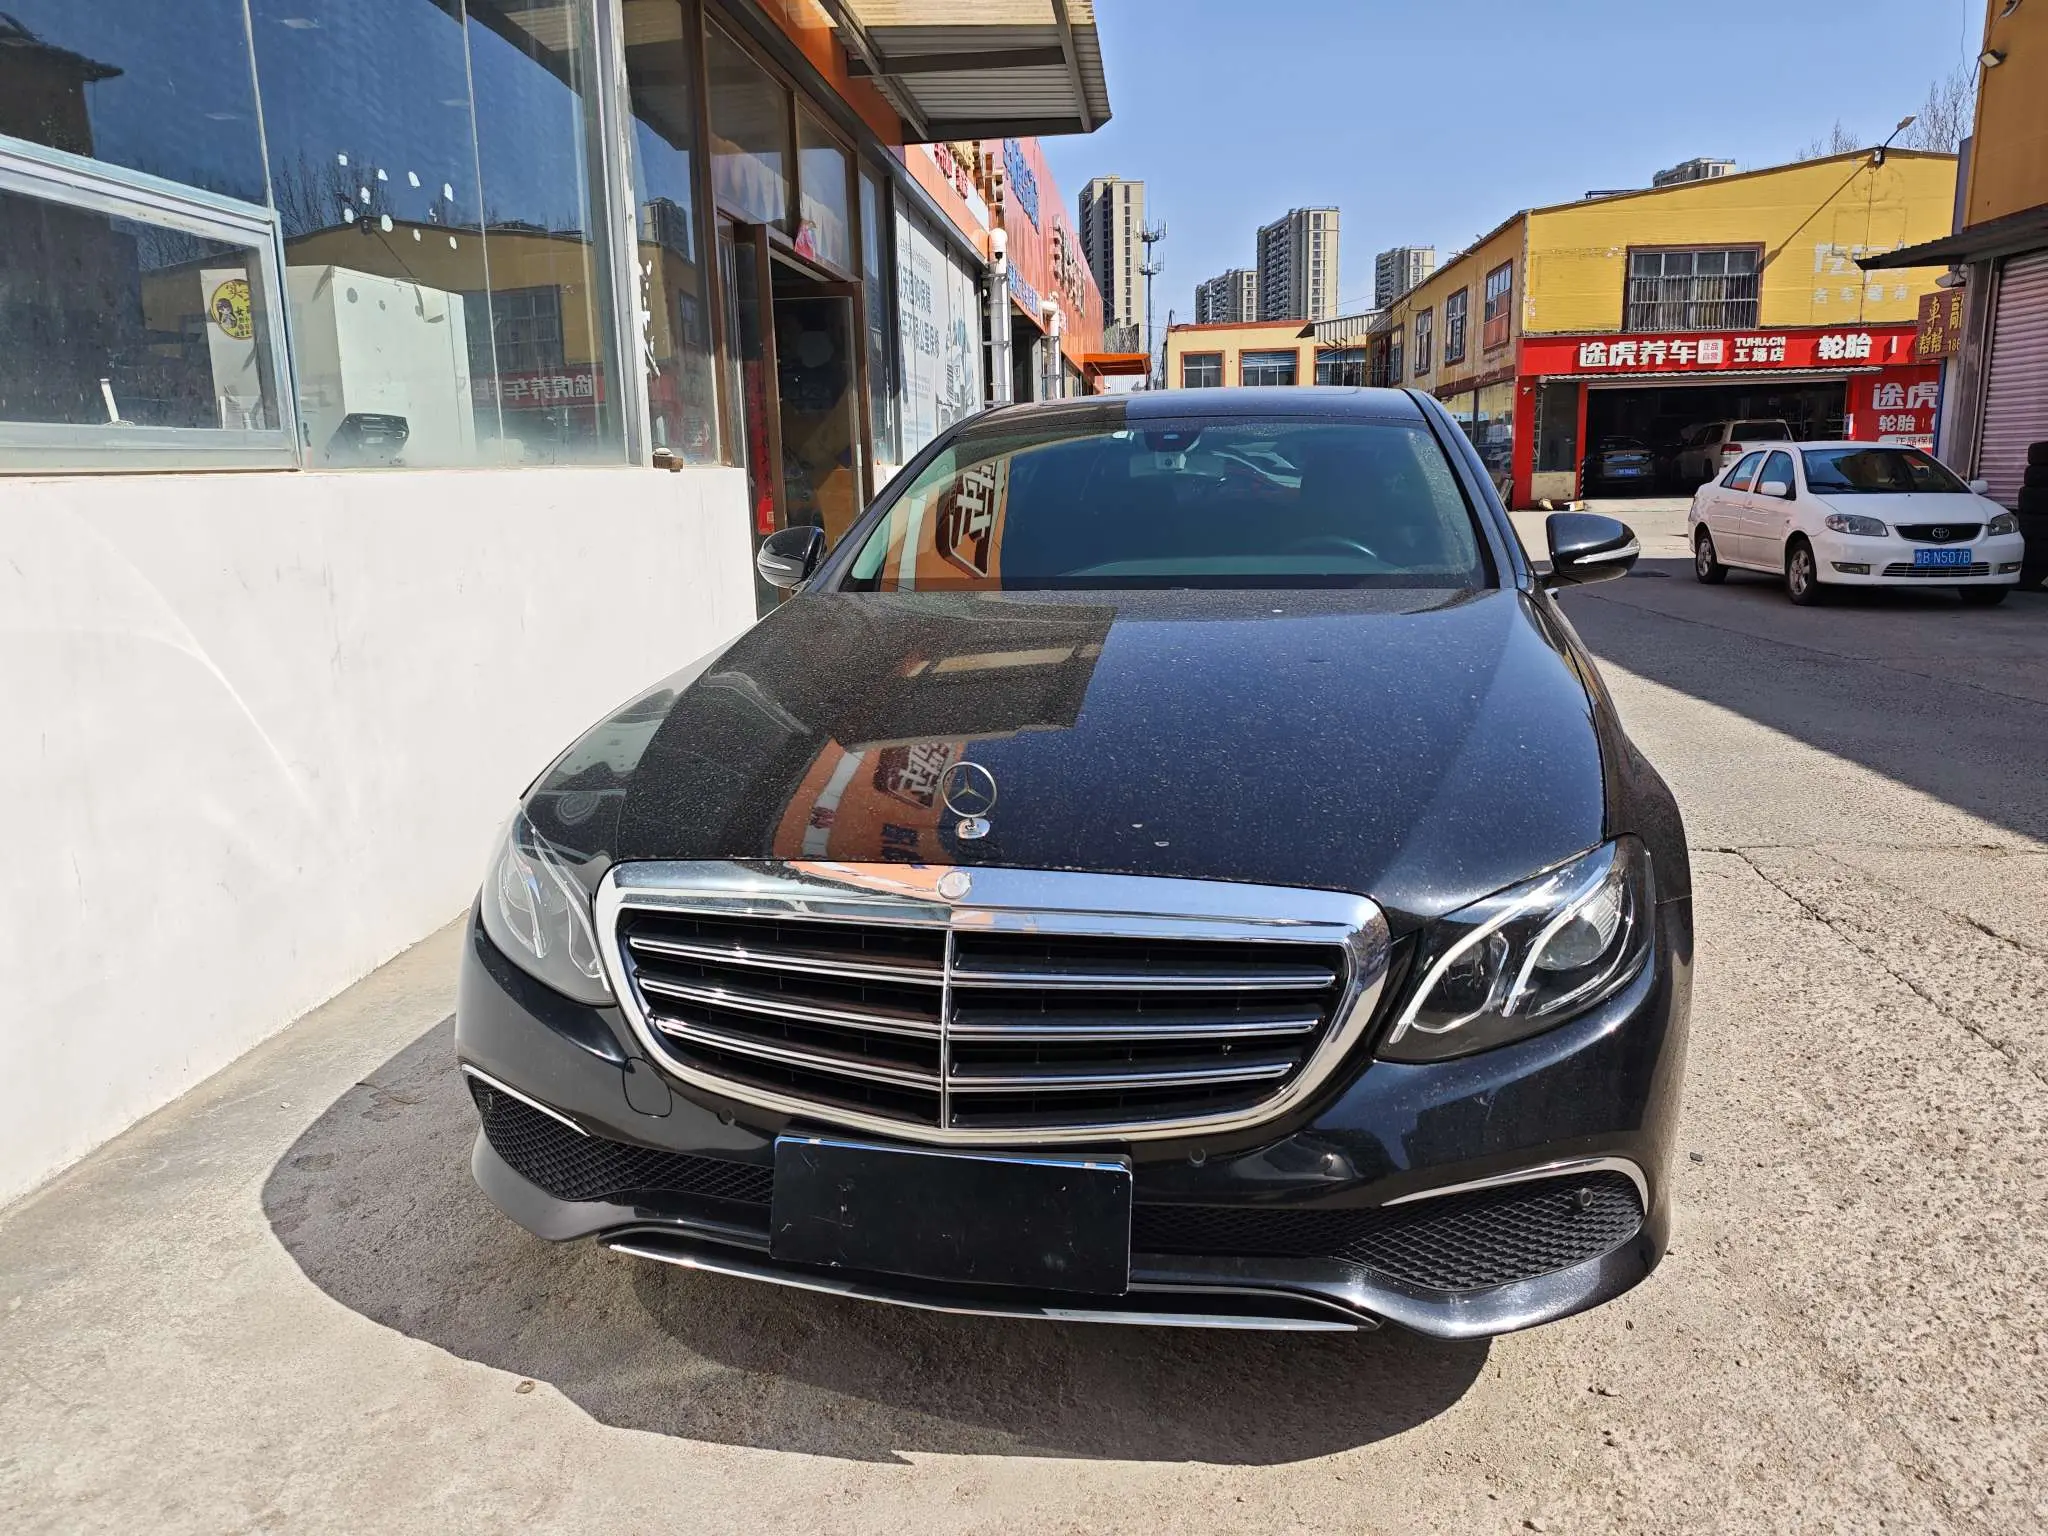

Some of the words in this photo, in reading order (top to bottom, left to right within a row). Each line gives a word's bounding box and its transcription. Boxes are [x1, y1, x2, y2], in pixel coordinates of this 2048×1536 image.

[1734, 336, 1785, 347] TUHU.CN
[1818, 333, 1873, 360] 轮胎
[1579, 339, 1697, 367] 途虎养车
[1733, 347, 1785, 362] 工场店
[1879, 415, 1915, 432] 轮胎
